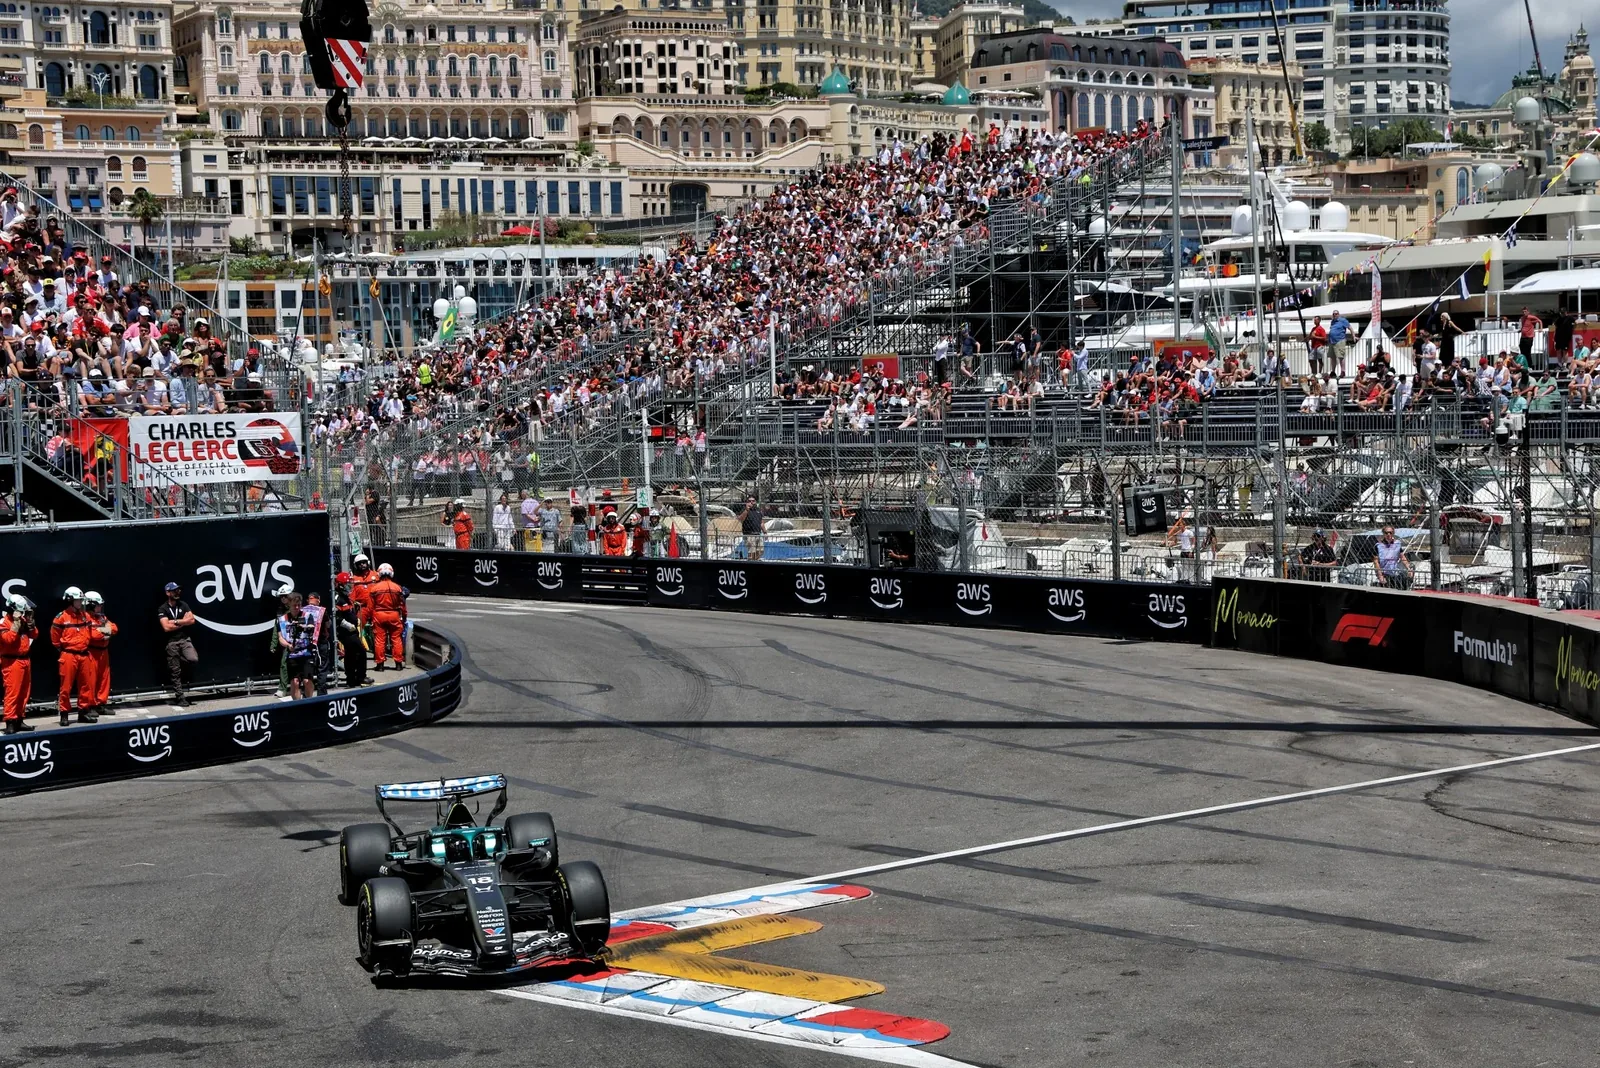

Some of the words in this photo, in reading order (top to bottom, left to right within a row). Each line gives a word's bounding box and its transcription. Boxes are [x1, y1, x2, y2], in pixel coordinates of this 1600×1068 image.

[1186, 140, 1213, 149] salesforce
[148, 421, 237, 441] CHARLES
[134, 439, 239, 464] LECLERC
[195, 468, 215, 476] FAN
[220, 467, 246, 475] CLUB
[1142, 497, 1156, 507] aws
[415, 556, 438, 571] aws
[474, 559, 498, 574] aws
[537, 562, 562, 577] aws
[195, 559, 295, 604] aws
[656, 567, 683, 583] aws
[718, 570, 747, 586] aws
[795, 574, 825, 591] aws
[870, 578, 902, 596] aws
[957, 583, 991, 602] aws
[1048, 588, 1085, 608] aws
[1148, 593, 1186, 614] aws
[1214, 586, 1279, 641] Monaco
[398, 683, 418, 703] aws
[328, 697, 358, 718] aws
[233, 711, 270, 733] aws
[128, 725, 171, 747] aws
[4, 740, 52, 764] aws
[467, 876, 494, 885] 18
[515, 932, 569, 953] aramco
[413, 948, 472, 958] aramco
